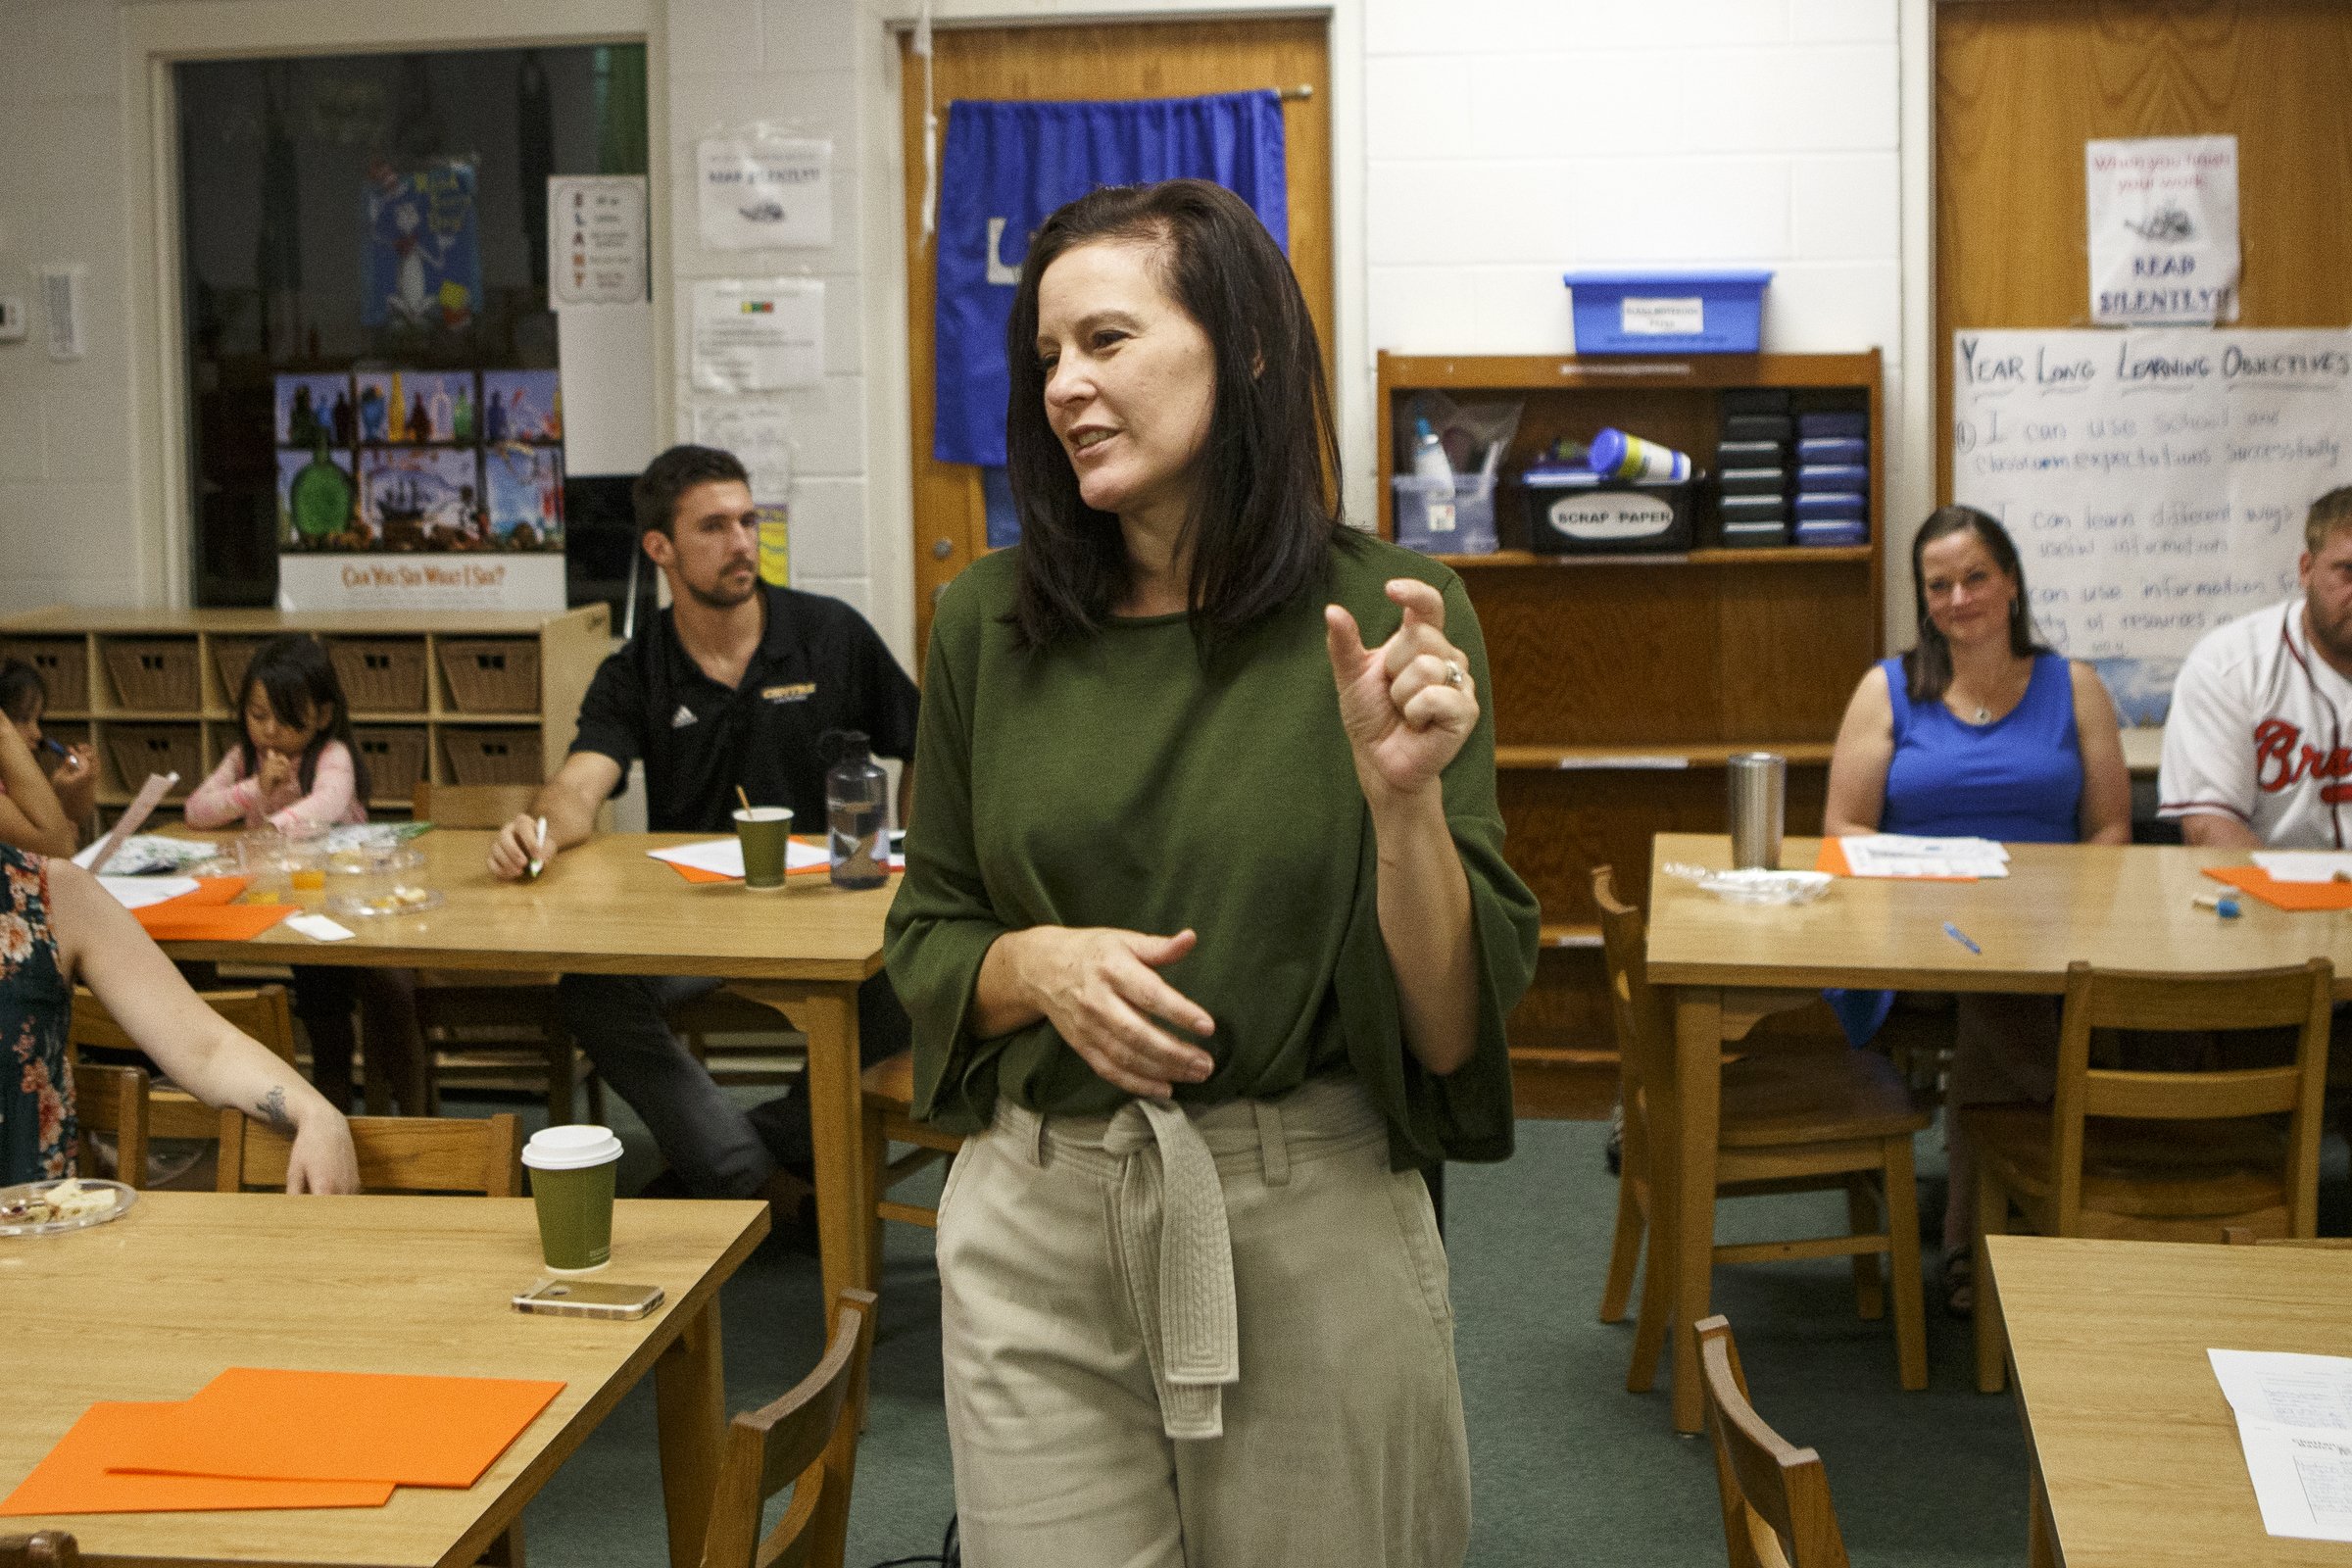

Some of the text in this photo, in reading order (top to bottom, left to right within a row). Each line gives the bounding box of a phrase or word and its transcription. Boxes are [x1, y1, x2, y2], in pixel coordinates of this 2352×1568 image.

[2133, 255, 2196, 276] READ
[1961, 338, 2026, 384] YEAR
[2037, 345, 2096, 383] LONG
[2117, 341, 2211, 378] LEARNING
[1558, 510, 1670, 524] SCRAP PAPER
